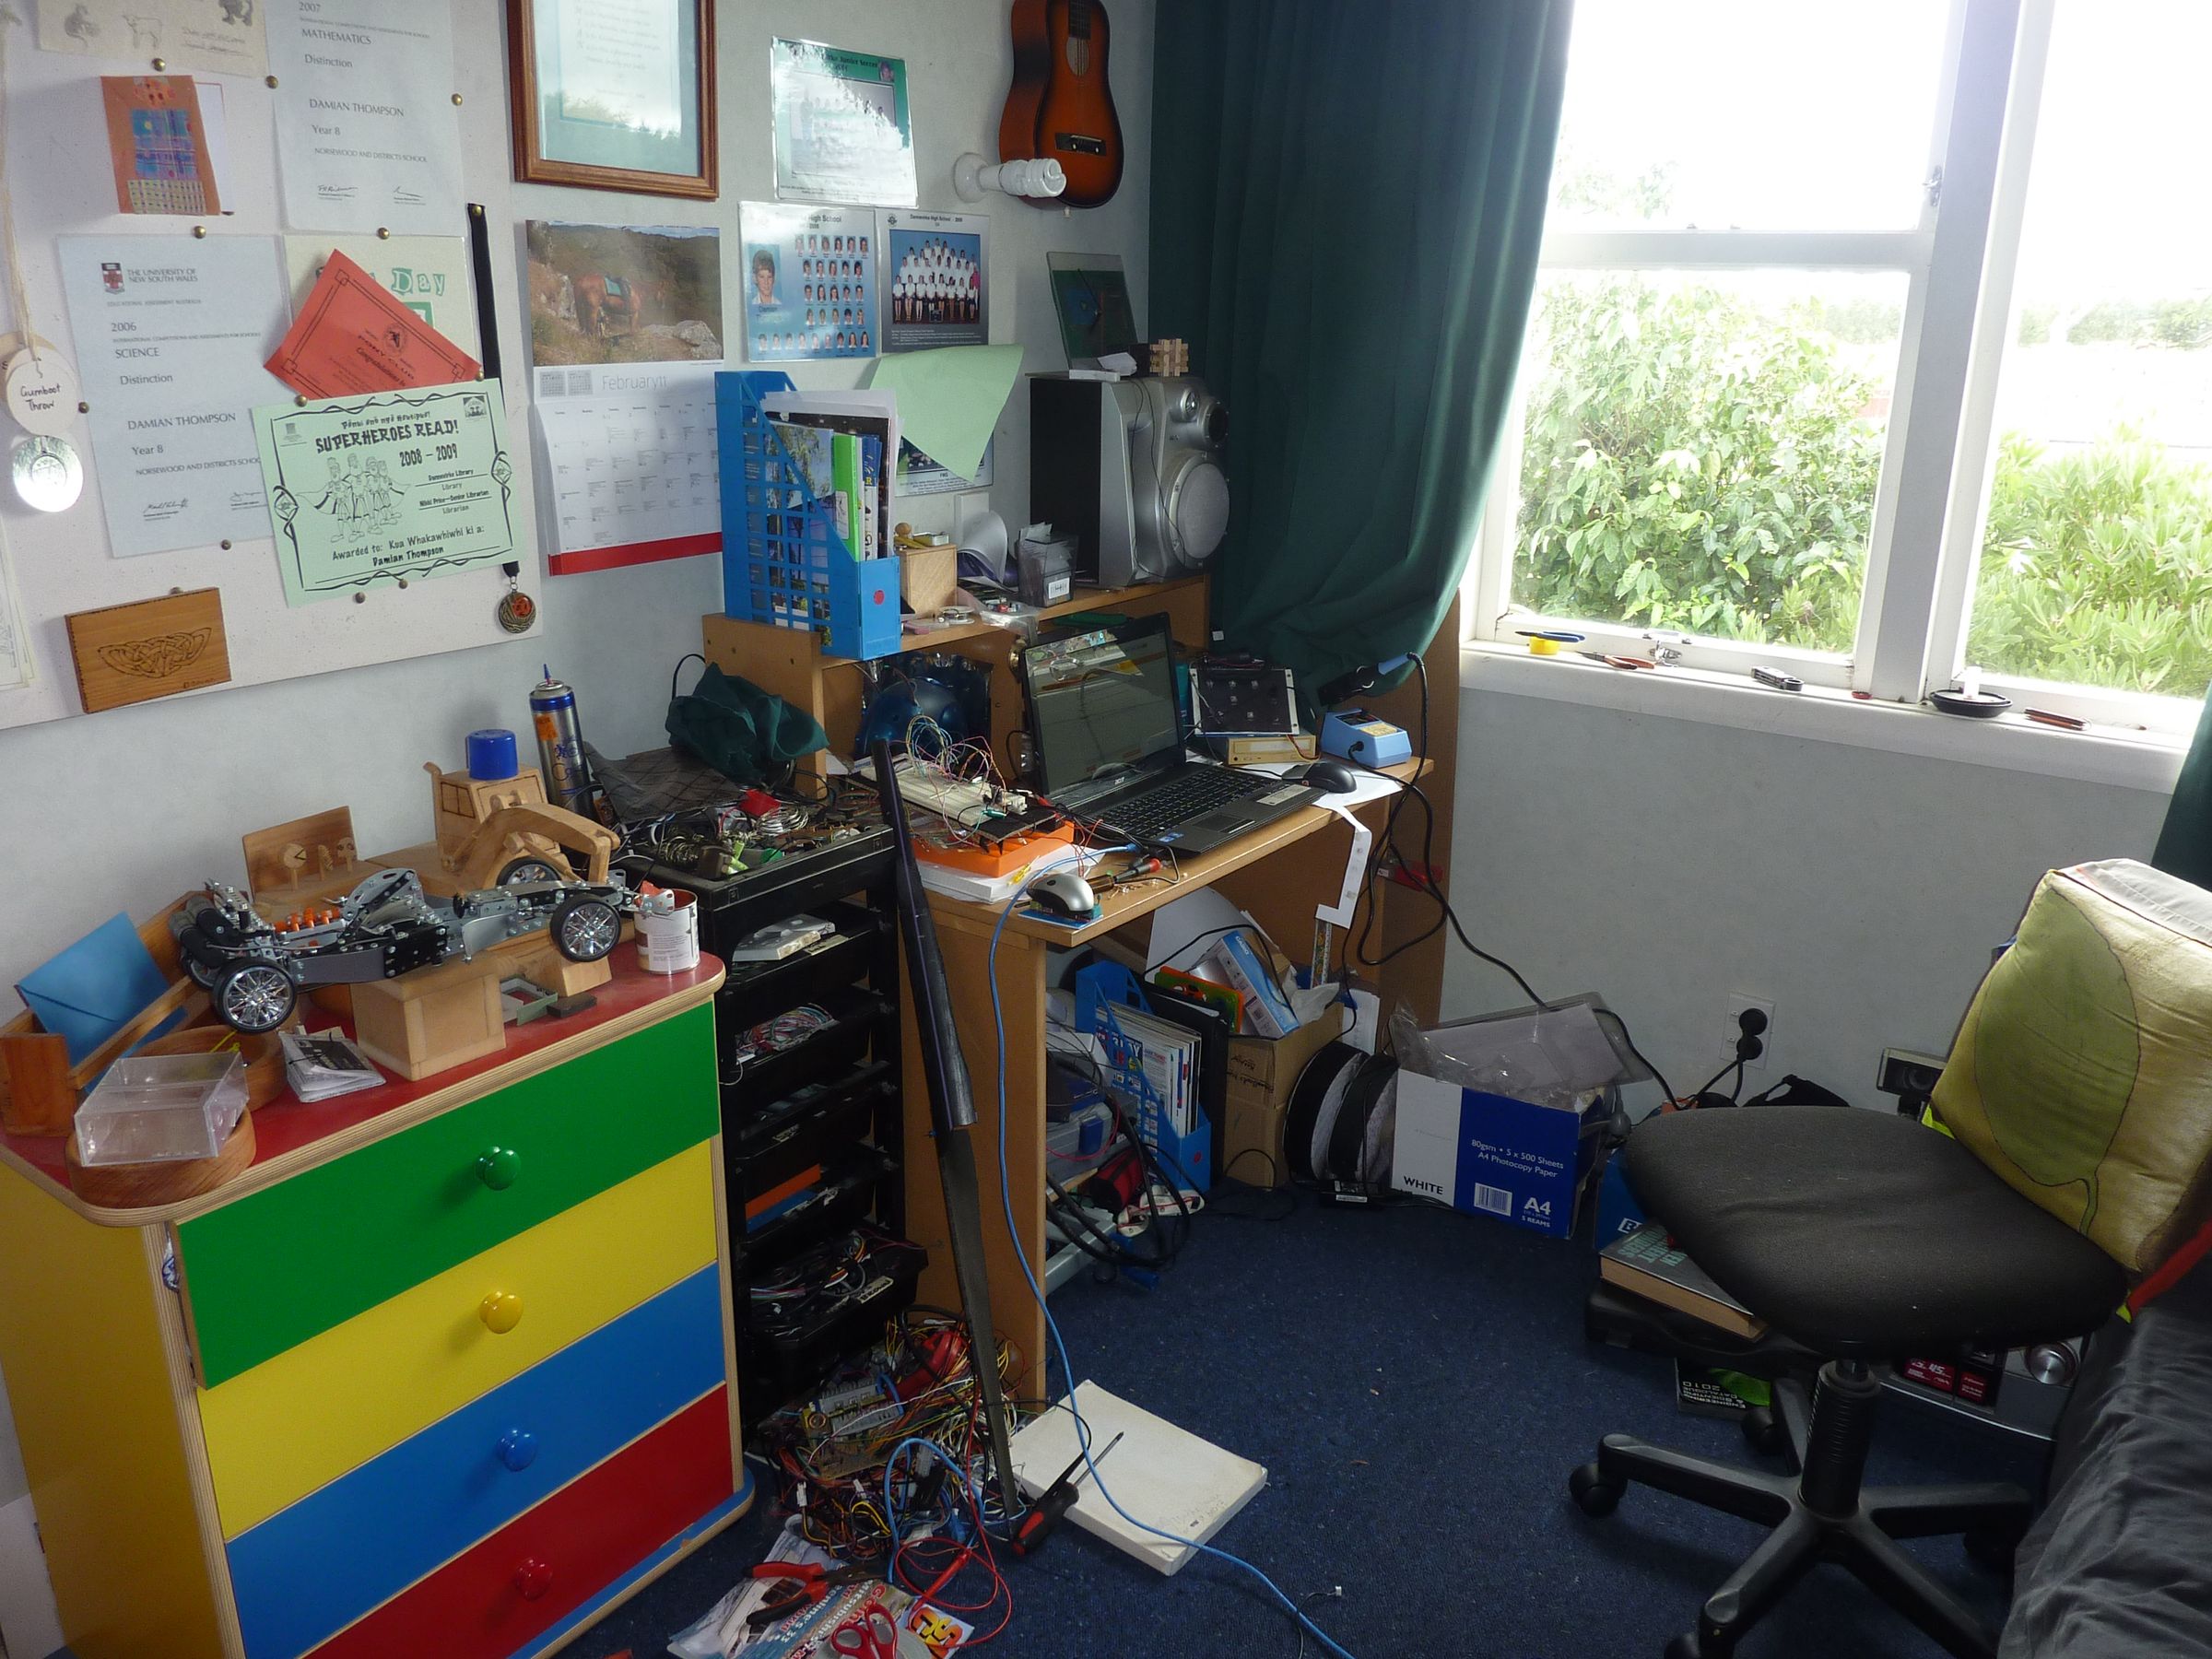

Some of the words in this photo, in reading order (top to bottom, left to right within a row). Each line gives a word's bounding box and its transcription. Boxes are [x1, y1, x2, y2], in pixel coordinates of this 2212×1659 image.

[299, 1, 321, 13] 2007
[301, 29, 371, 45] MATHEMATICS
[304, 53, 353, 68] Distinction
[310, 98, 350, 112] DAMIAN
[353, 102, 404, 117] THOMPSON
[312, 124, 332, 135] Year
[335, 126, 341, 135] 8
[314, 147, 358, 158] NORSEWOOD
[359, 150, 372, 159] AND
[402, 155, 427, 163] SCHOOL
[142, 268, 185, 277] UNIVERSITY
[176, 275, 198, 283] WALES
[392, 267, 445, 297] Day
[112, 323, 136, 333] 2006
[115, 347, 159, 359] SCIENCE
[120, 374, 173, 385] Distinction
[20, 383, 61, 397] Gumboot
[26, 398, 55, 411] Throw
[127, 418, 173, 430] DAMIAN
[176, 413, 236, 426] THOMPSON
[315, 424, 412, 453] SUPERHEROES
[415, 419, 459, 438] READ!
[132, 446, 154, 455] Year
[157, 444, 163, 453] 8
[399, 448, 423, 467] 2008
[435, 443, 458, 462] 2009
[135, 465, 185, 476] NORSEWOOD
[204, 459, 237, 469] DISTRICTS
[442, 482, 463, 490] Library
[442, 505, 469, 514] Librarian
[332, 545, 369, 561] Awarded
[371, 544, 383, 553] to:
[406, 527, 464, 547] Whakawhiwhi
[465, 525, 475, 535] ki
[372, 554, 404, 567] Damian
[406, 547, 444, 560] Thompson
[1471, 1139, 1497, 1153] 80gsm
[1506, 1148, 1512, 1157] 5
[1521, 1152, 1535, 1163] 500
[1537, 1156, 1564, 1170] Sheets
[1477, 1151, 1488, 1161] A4
[1491, 1155, 1533, 1173] Photocopy
[1535, 1166, 1558, 1178] Paper
[1404, 1176, 1444, 1195] WHITE
[1524, 1197, 1551, 1216] A4
[1527, 1217, 1551, 1229] REAMS
[1682, 1381, 1721, 1392] 2010
